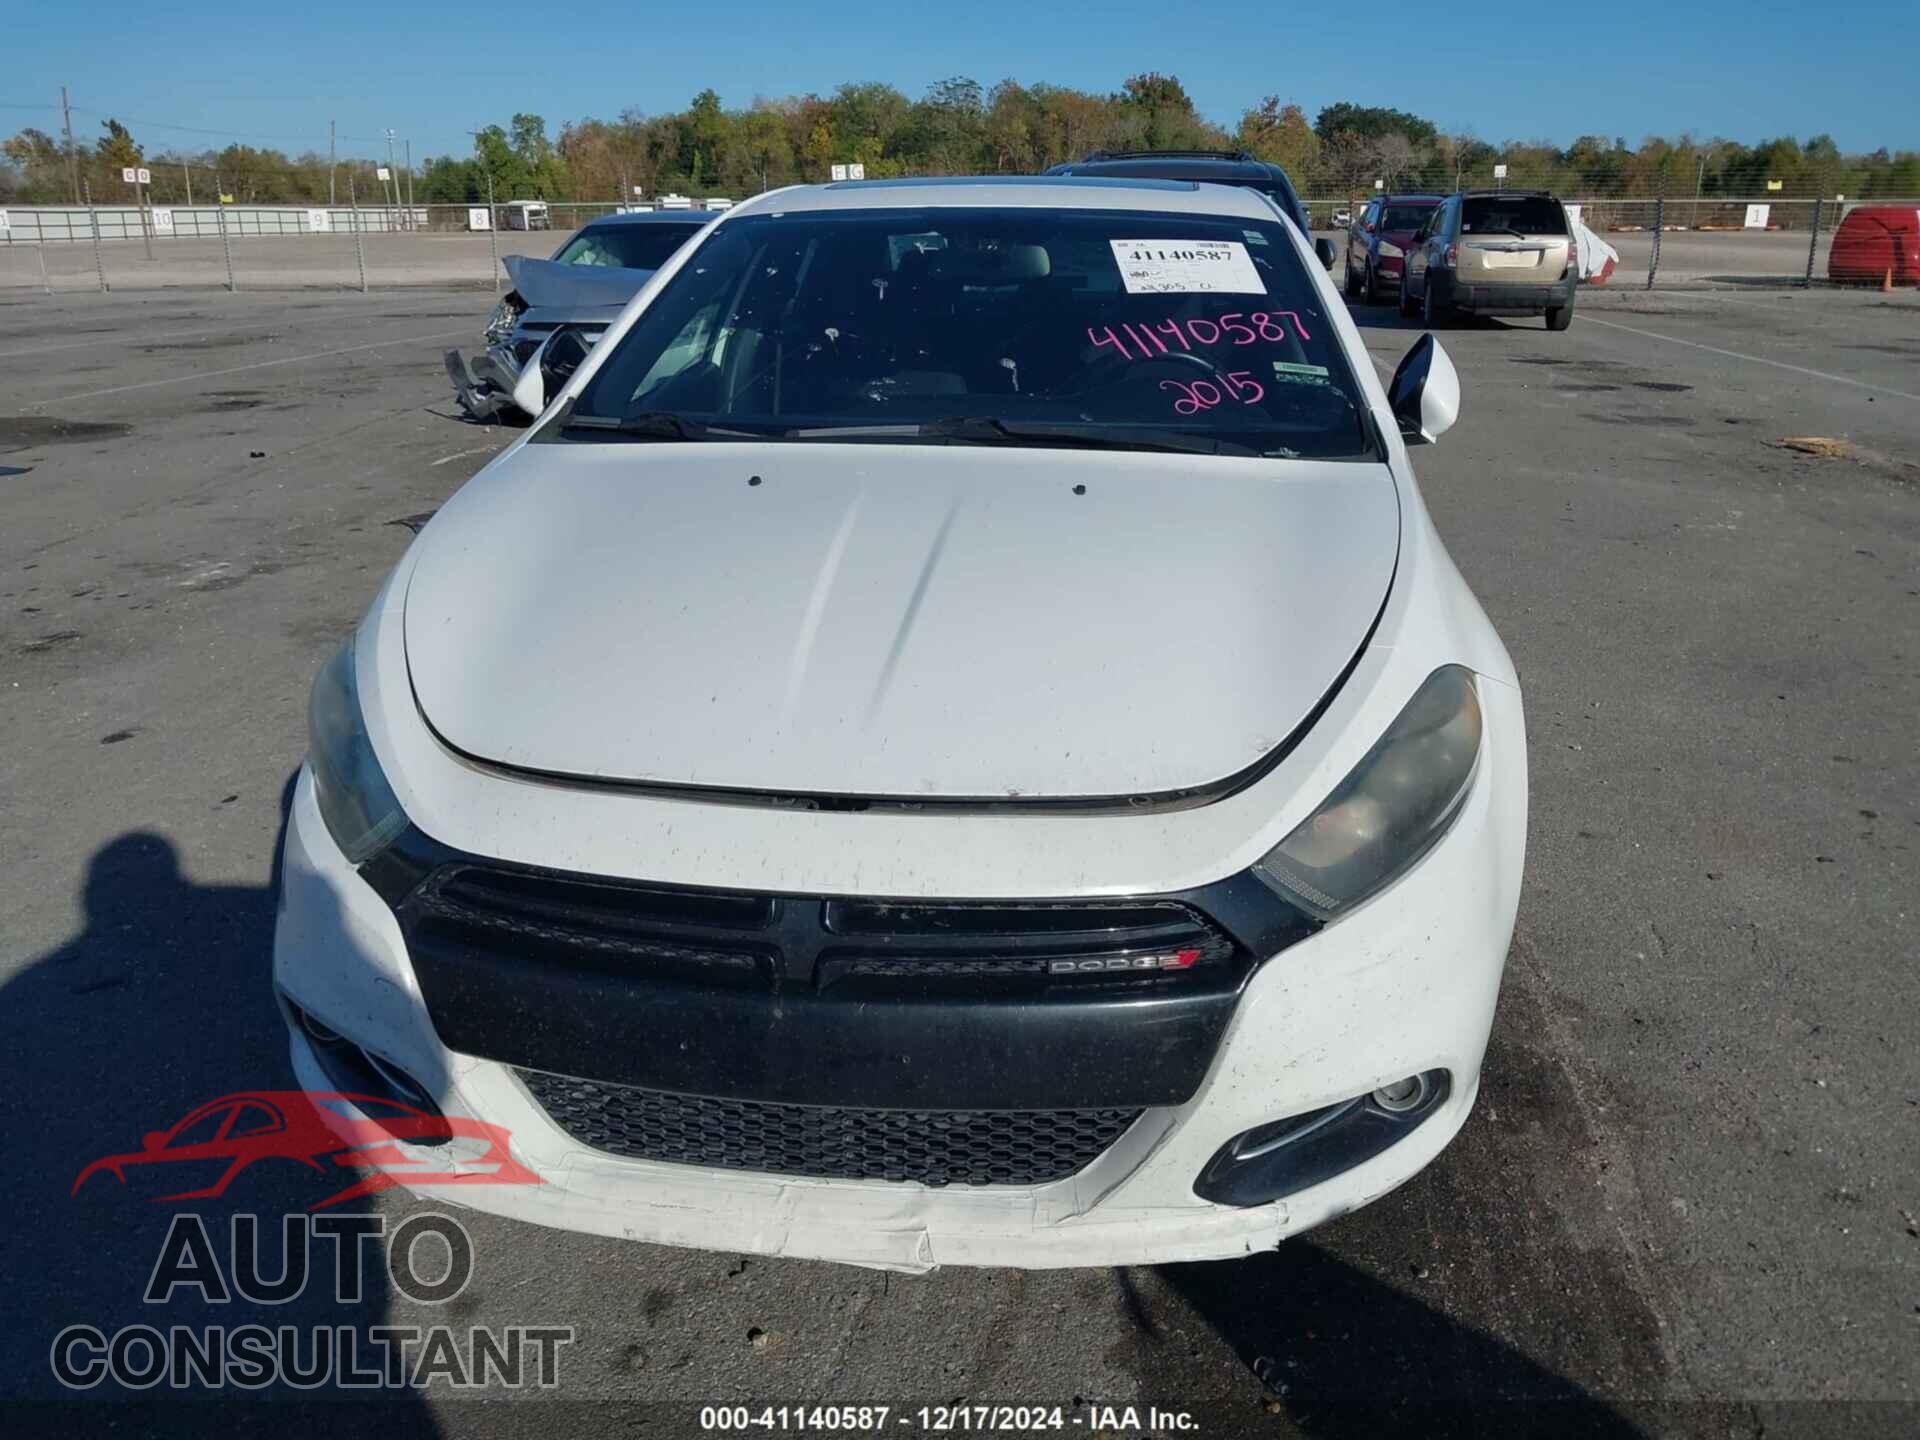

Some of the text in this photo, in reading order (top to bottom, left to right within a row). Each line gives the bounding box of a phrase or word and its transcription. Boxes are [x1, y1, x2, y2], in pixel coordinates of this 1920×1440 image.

[1129, 250, 1232, 261] 41140587
[1088, 312, 1311, 360] 41140587
[1159, 371, 1265, 414] 2015
[1051, 955, 1182, 972] DODGE
